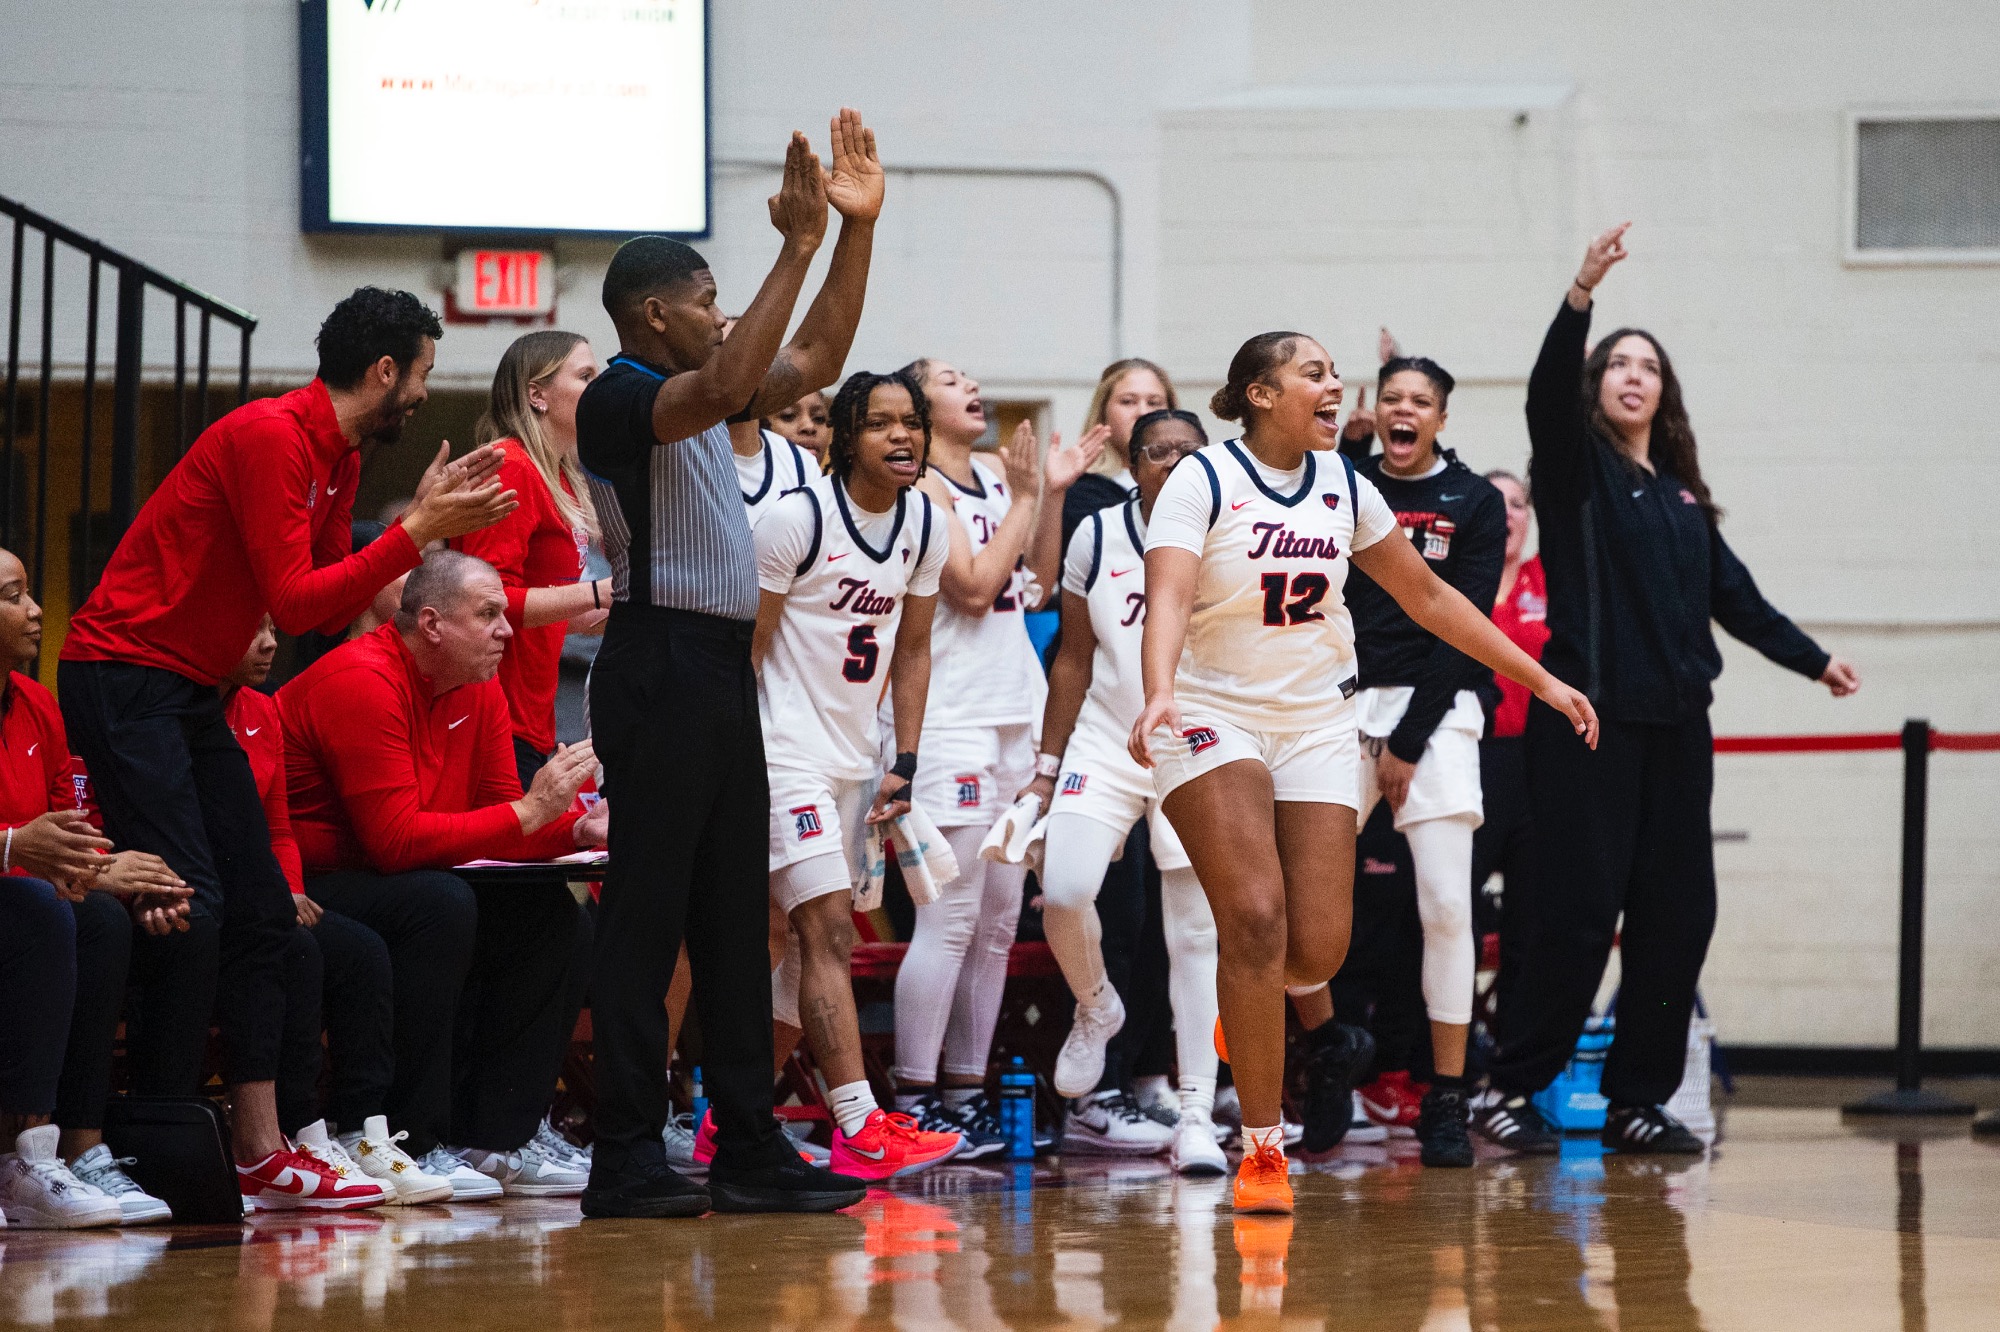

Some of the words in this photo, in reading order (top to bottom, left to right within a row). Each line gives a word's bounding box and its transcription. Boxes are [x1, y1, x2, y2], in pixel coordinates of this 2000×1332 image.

[475, 250, 542, 310] EXIT
[1247, 521, 1340, 560] Titans
[829, 577, 896, 615] Titan
[1260, 571, 1330, 627] 12
[841, 623, 880, 684] 5
